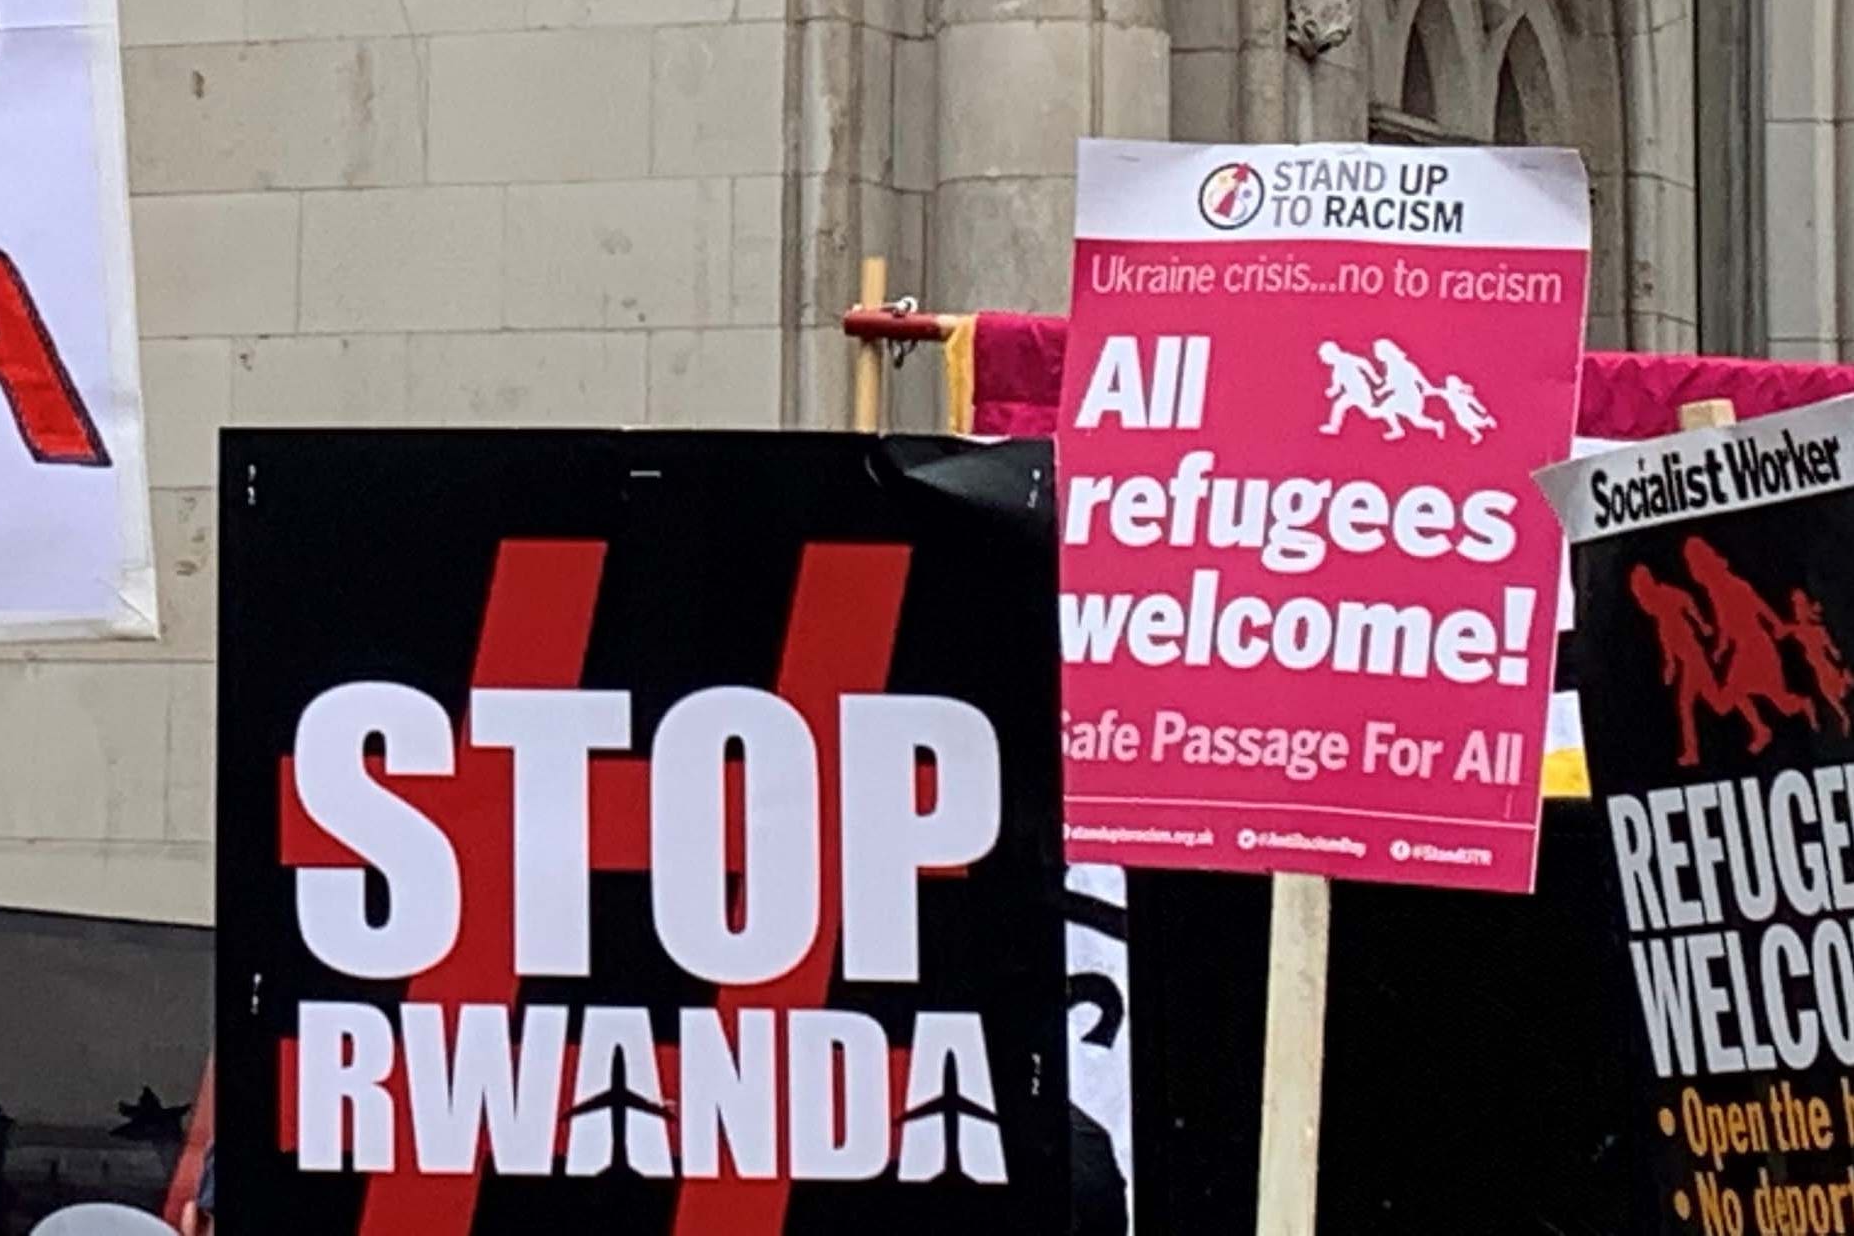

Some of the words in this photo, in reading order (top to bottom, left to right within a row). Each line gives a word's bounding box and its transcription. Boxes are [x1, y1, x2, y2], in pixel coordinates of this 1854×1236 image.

[1272, 159, 1387, 194] STAND
[1400, 162, 1449, 196] UP
[1272, 195, 1312, 227] TO
[1323, 196, 1464, 233] RACISM
[1091, 254, 1215, 294] Ukraine
[1393, 259, 1429, 298] to
[1439, 262, 1562, 303] racism
[1073, 336, 1211, 429] All
[1064, 450, 1517, 572] refugees
[1590, 448, 1728, 529] Socialist
[1723, 429, 1841, 501] Worker
[1059, 569, 1537, 686] welcome!
[1151, 710, 1349, 781] Passage
[1362, 721, 1443, 778] For
[1453, 730, 1524, 786] All
[294, 681, 1001, 984] STOP
[1607, 763, 1854, 932] REFUGE
[1628, 918, 1854, 1078] WELCO
[297, 1001, 1008, 1184] RWANDA
[1682, 1087, 1769, 1172] Open
[1769, 1079, 1834, 1153] the
[1695, 1170, 1744, 1236] No
